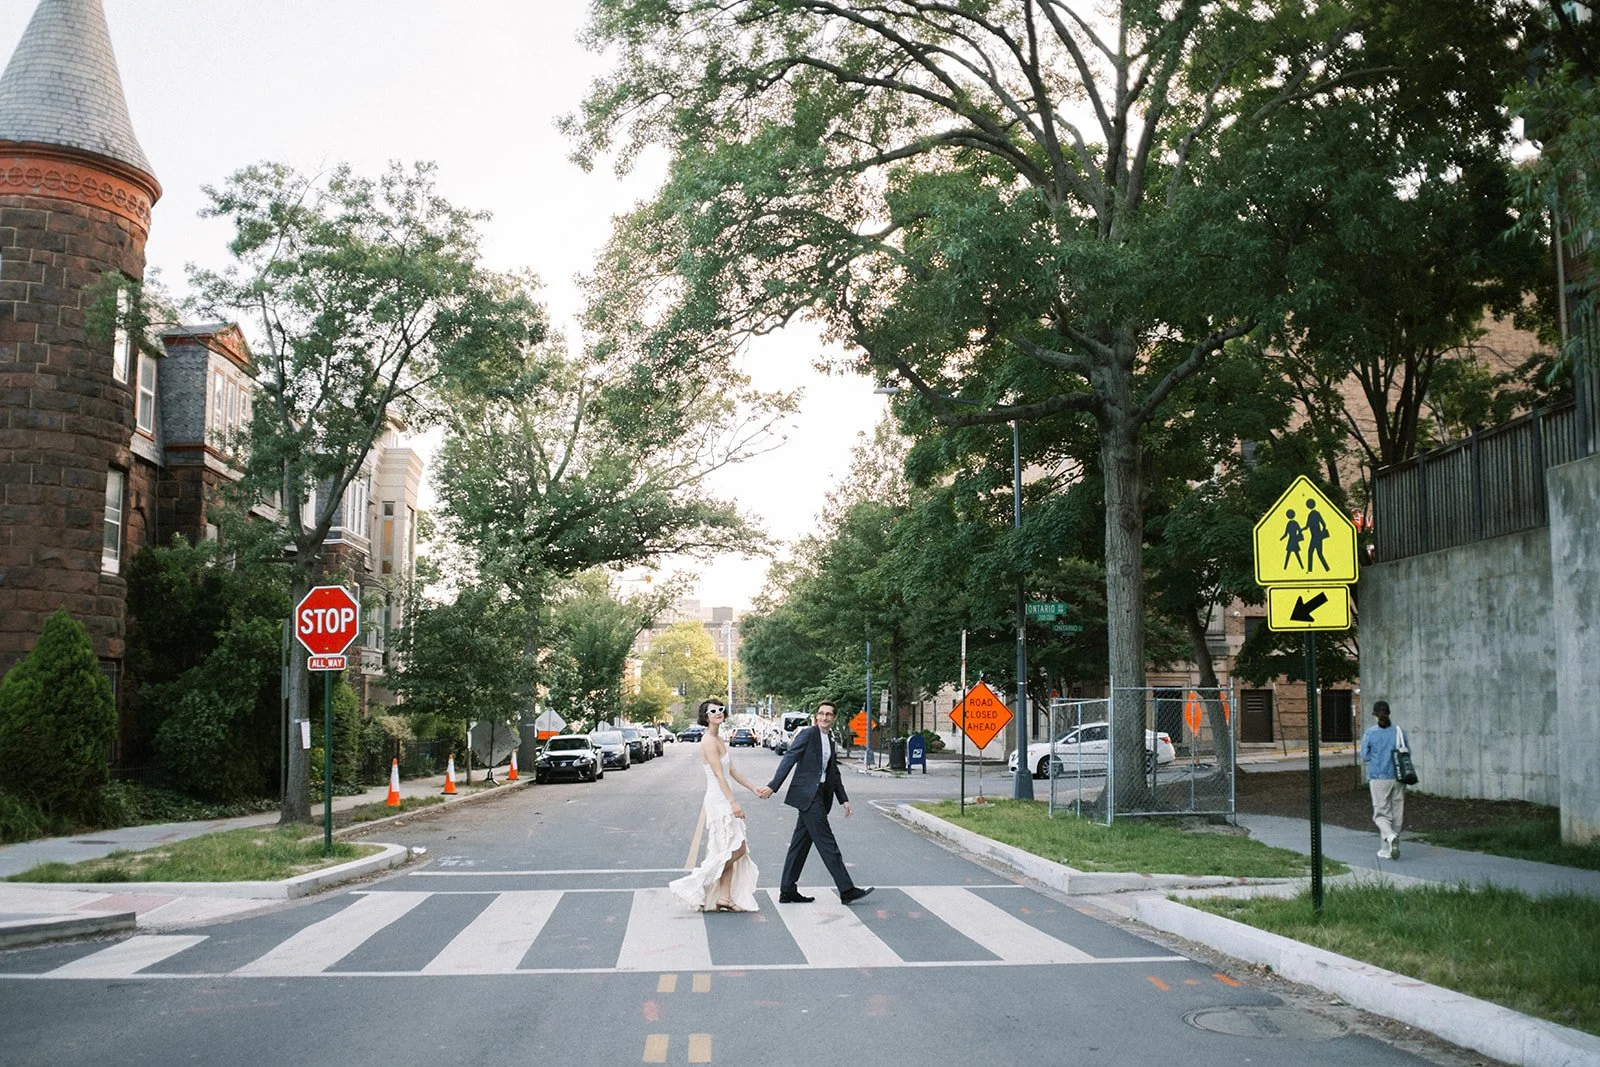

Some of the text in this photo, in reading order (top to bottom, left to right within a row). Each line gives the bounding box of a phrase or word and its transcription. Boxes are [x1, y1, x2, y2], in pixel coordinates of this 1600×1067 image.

[1028, 604, 1055, 613] ONTARIO
[300, 608, 354, 634] STOP
[312, 659, 342, 668] ALL WAY
[968, 723, 996, 731] AHEAD
